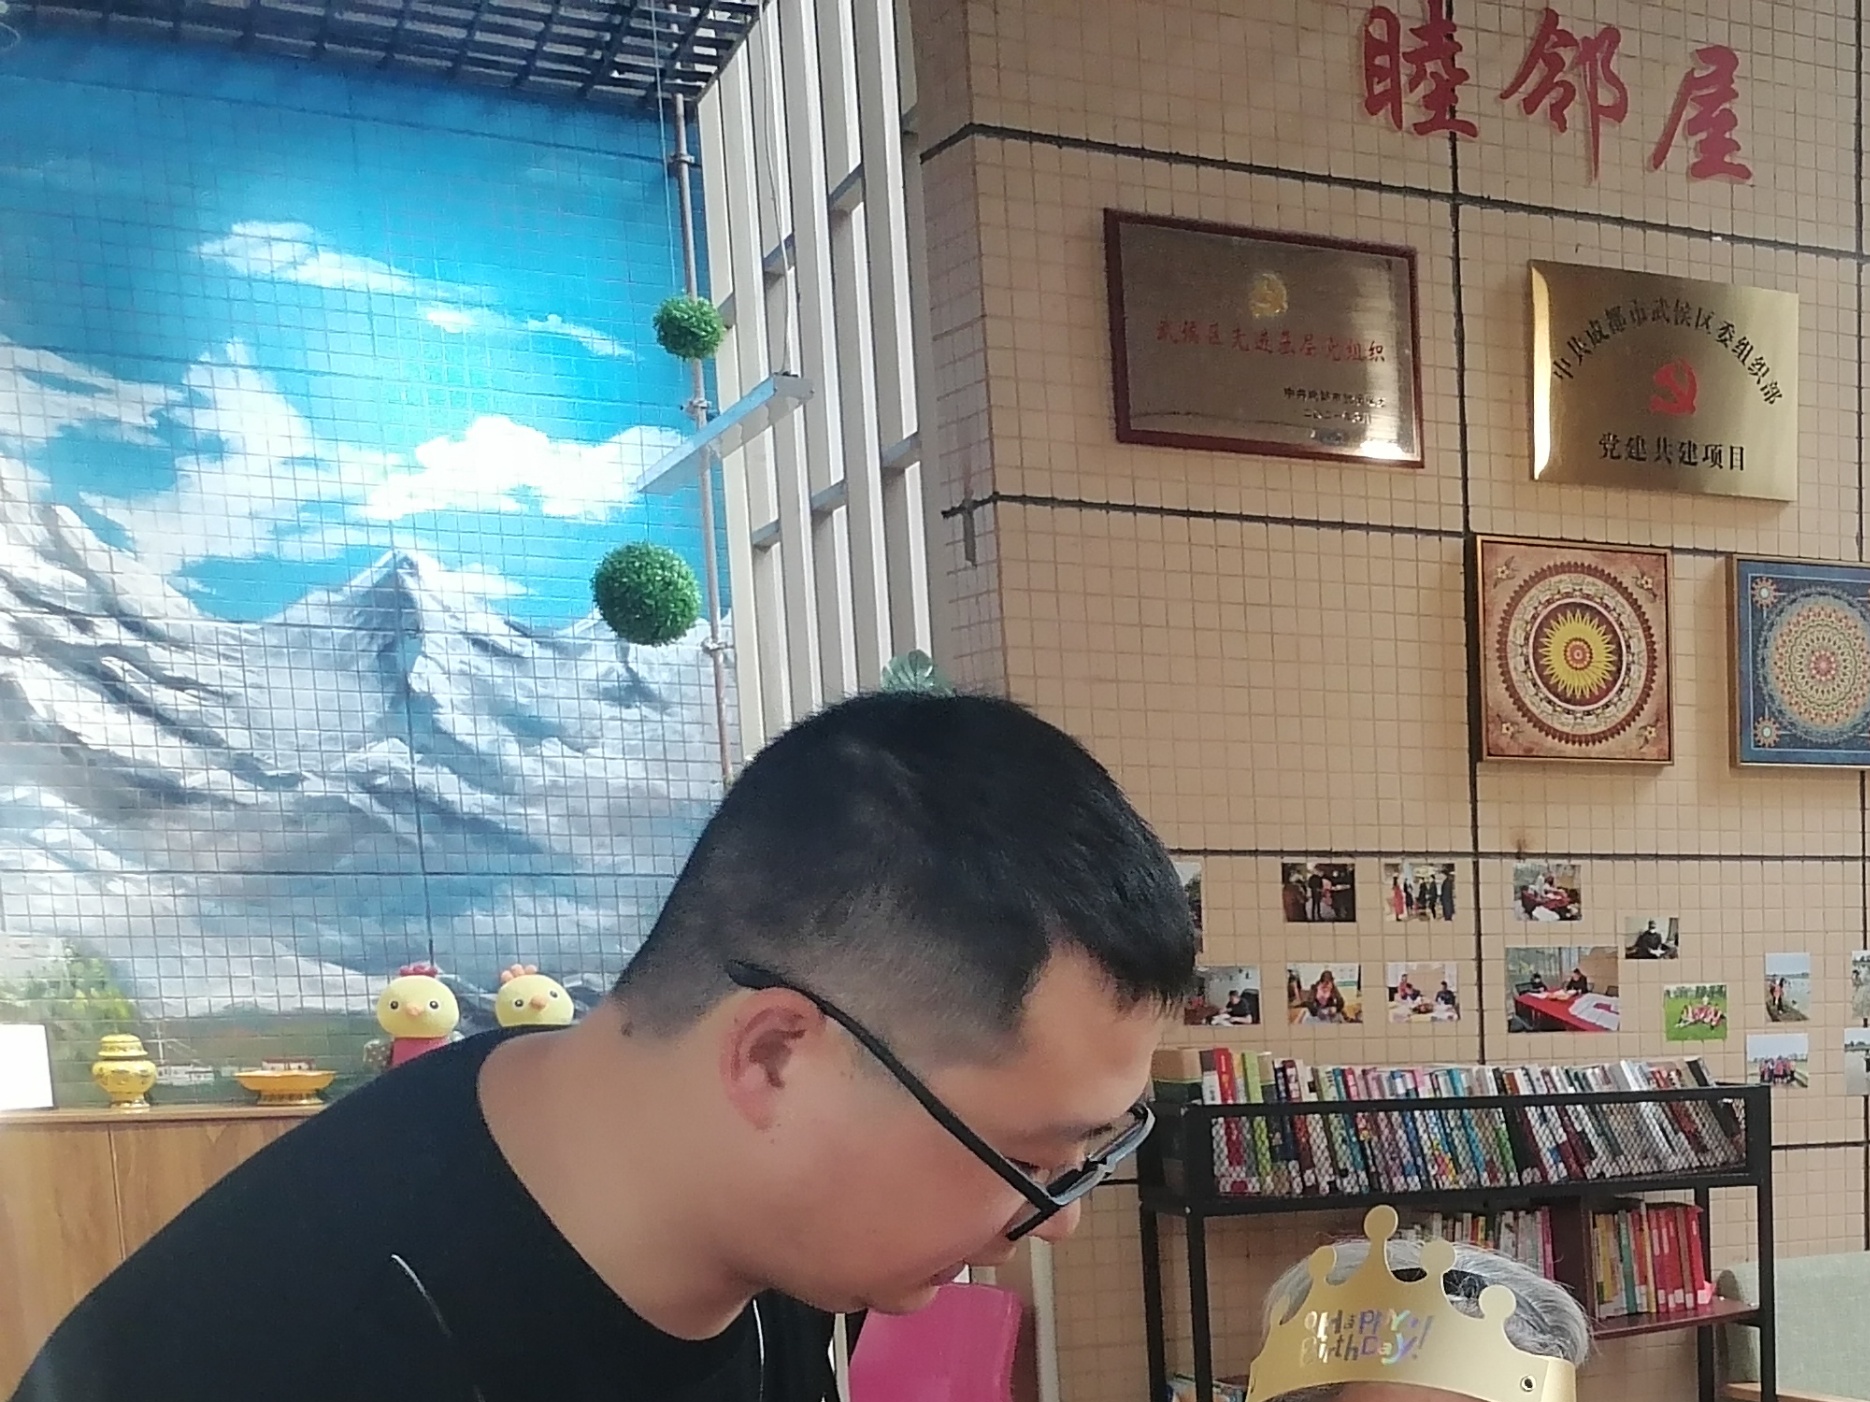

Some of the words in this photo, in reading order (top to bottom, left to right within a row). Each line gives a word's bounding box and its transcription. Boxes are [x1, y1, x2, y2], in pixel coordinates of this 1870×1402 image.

[1363, 0, 1752, 182] 睦邻屋
[1552, 298, 1783, 405] 中共成都市武侯区委组织部
[1598, 431, 1745, 472] 党建共建项目
